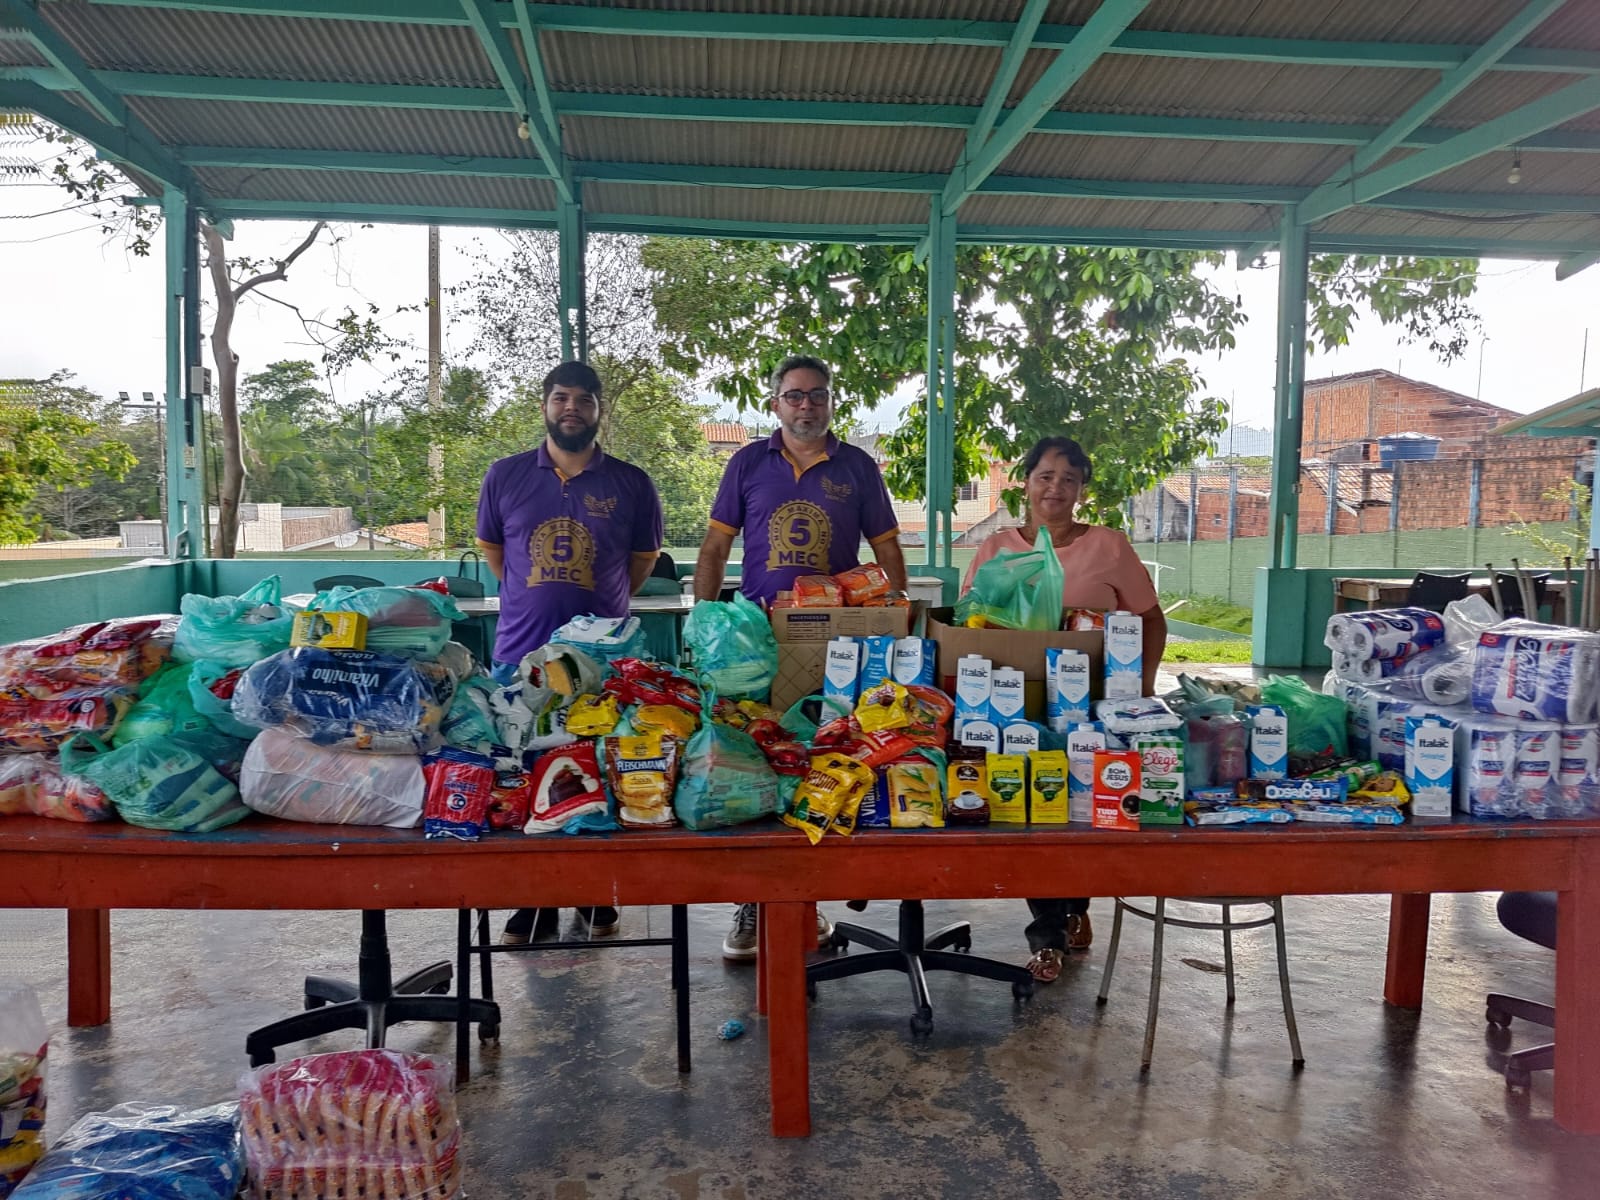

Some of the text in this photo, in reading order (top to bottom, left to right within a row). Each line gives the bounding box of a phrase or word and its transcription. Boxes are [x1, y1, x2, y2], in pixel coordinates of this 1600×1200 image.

[789, 518, 810, 546] 5
[551, 535, 574, 562] 5
[778, 550, 818, 566] MEC
[541, 566, 582, 582] MEC
[1111, 625, 1140, 635] Italac
[830, 650, 854, 661] Italac
[896, 649, 918, 658] Italac
[961, 667, 988, 678] Italac
[1061, 664, 1087, 673] Italac
[312, 668, 379, 687] Vitamilho
[994, 679, 1021, 689] Italac
[1255, 726, 1284, 736] Italac
[966, 731, 995, 742] Italac
[1006, 735, 1036, 745] Italac
[1419, 738, 1449, 748] Italac
[1106, 774, 1129, 782] JESUS
